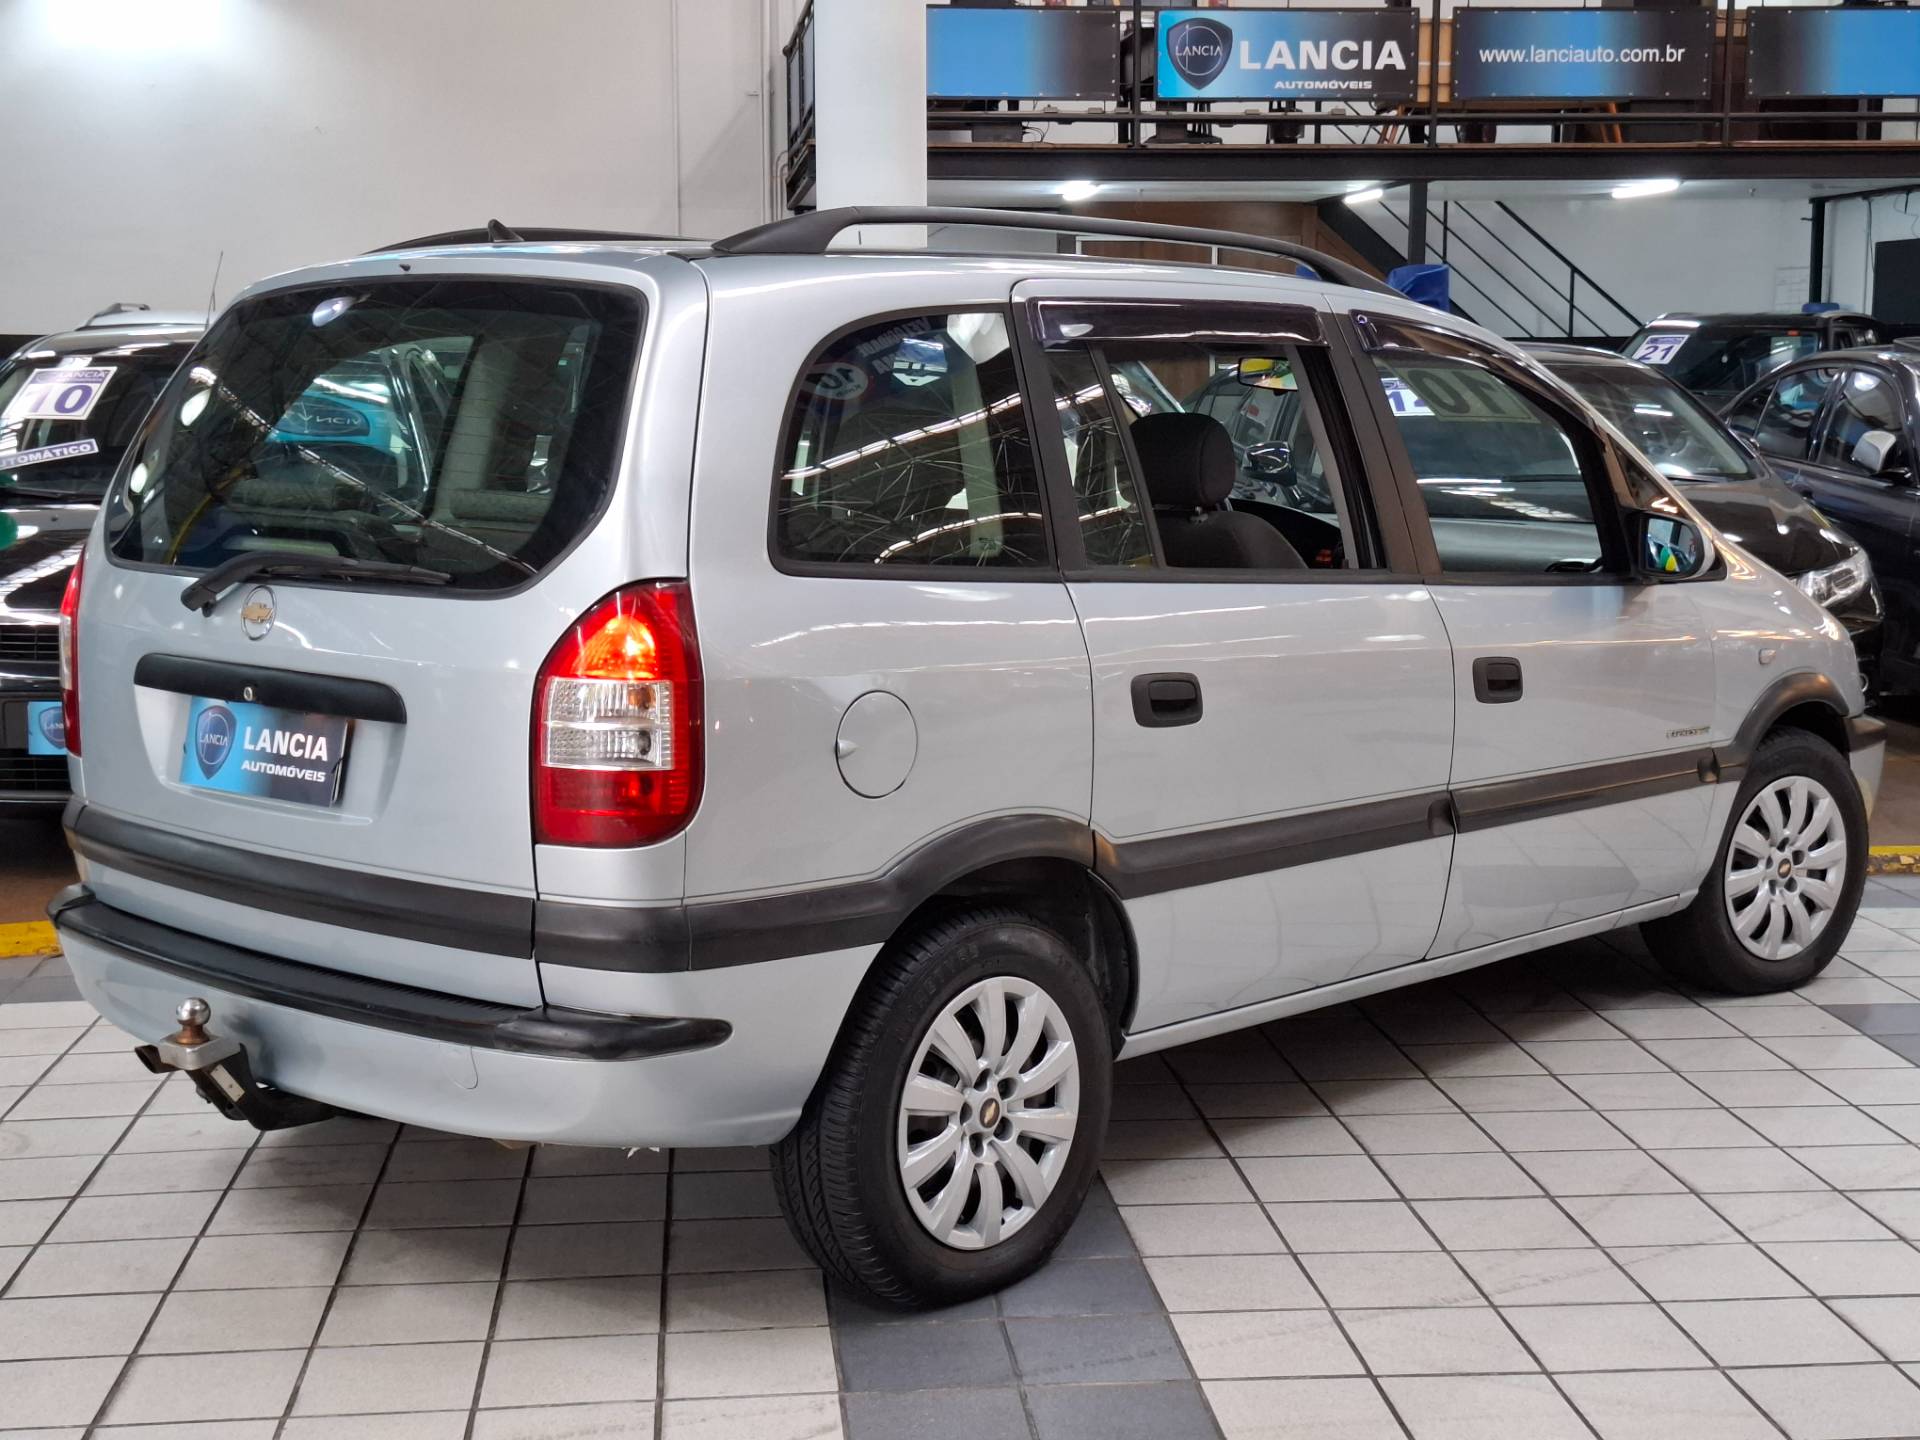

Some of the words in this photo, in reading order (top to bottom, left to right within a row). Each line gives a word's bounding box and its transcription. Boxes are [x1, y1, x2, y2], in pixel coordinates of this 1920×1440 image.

[1175, 44, 1223, 57] LANCIA
[1239, 40, 1407, 70] LANCIA
[1479, 45, 1686, 64] www.lanciauto.com.br
[1274, 80, 1373, 90] AUTOMÓVEIS
[1639, 345, 1675, 361] 21
[25, 384, 94, 415] 10
[243, 726, 328, 762] LANCIA
[240, 760, 327, 783] AUTOMÓVEIS
